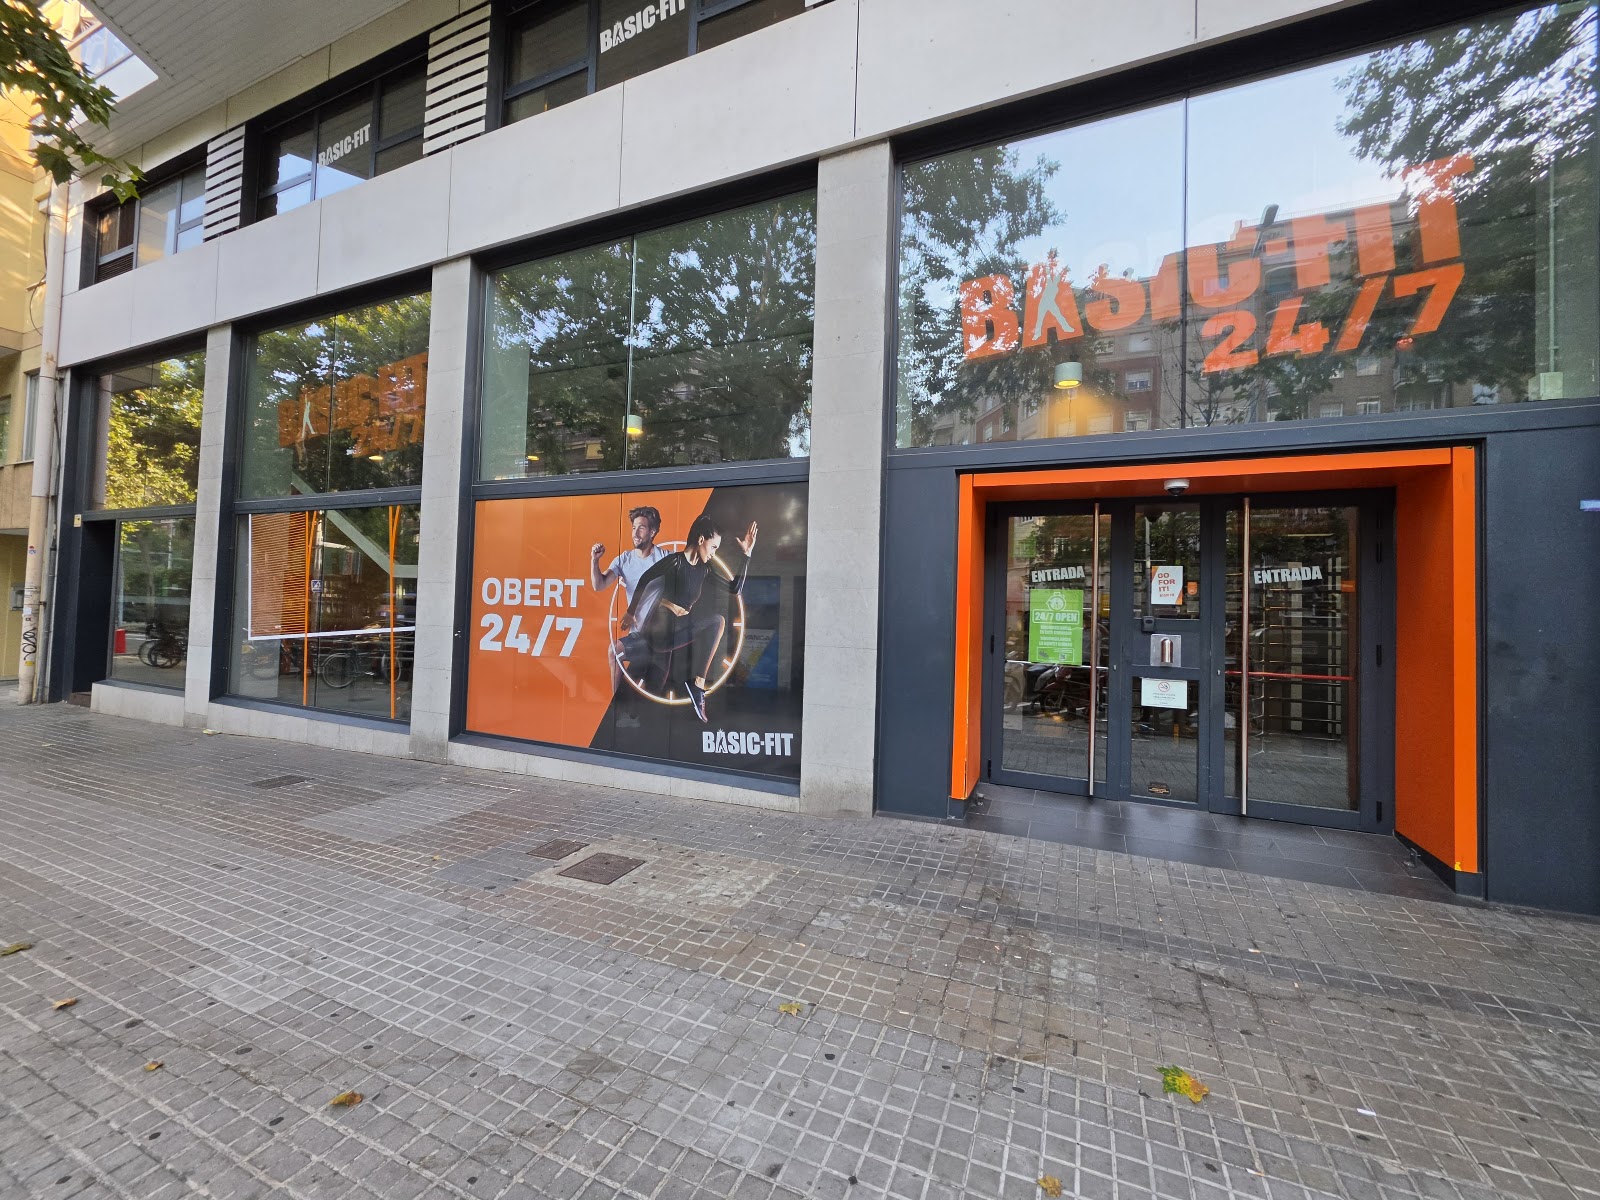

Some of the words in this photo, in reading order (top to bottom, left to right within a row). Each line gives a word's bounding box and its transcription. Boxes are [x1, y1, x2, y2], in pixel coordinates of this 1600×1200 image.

[318, 123, 371, 168] BASIC-FIT
[960, 155, 1475, 360] BASIC-FIT
[1202, 263, 1465, 374] 24/7
[1031, 566, 1085, 582] ENTRADA
[1253, 565, 1323, 584] ENTRADA
[482, 577, 585, 608] OBERT
[1035, 612, 1054, 621] 24/7
[1055, 612, 1078, 622] OPEN
[479, 613, 583, 657] 24/7
[702, 729, 794, 756] BASIC-FIT
